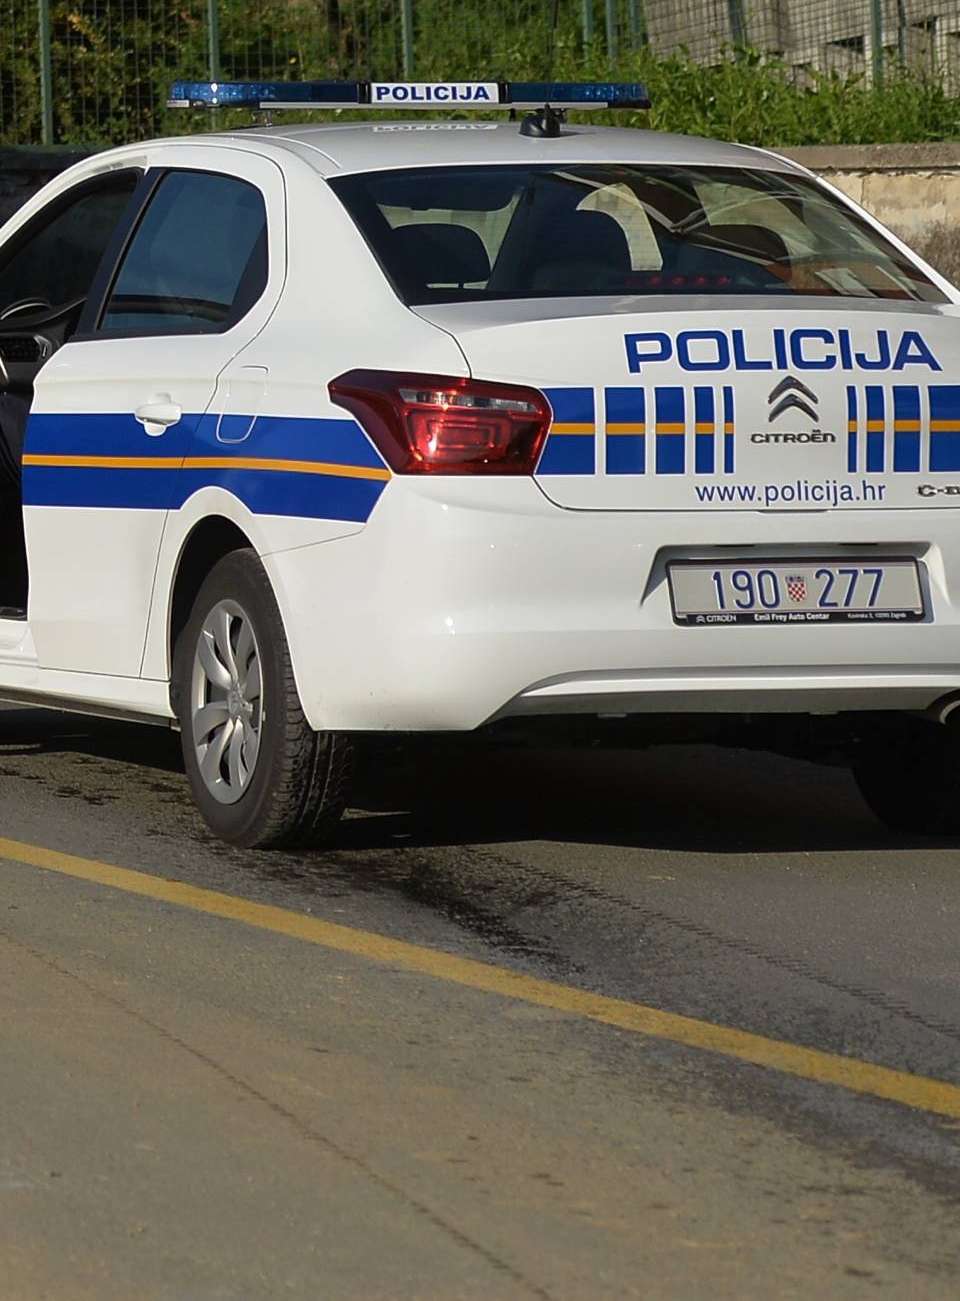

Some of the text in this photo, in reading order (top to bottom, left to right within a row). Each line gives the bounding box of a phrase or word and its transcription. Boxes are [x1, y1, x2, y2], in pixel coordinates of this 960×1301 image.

[375, 84, 491, 101] POLICIJA
[623, 328, 943, 374] POLICIJA
[695, 480, 886, 507] www.policija.hr
[712, 568, 884, 610] 190 277
